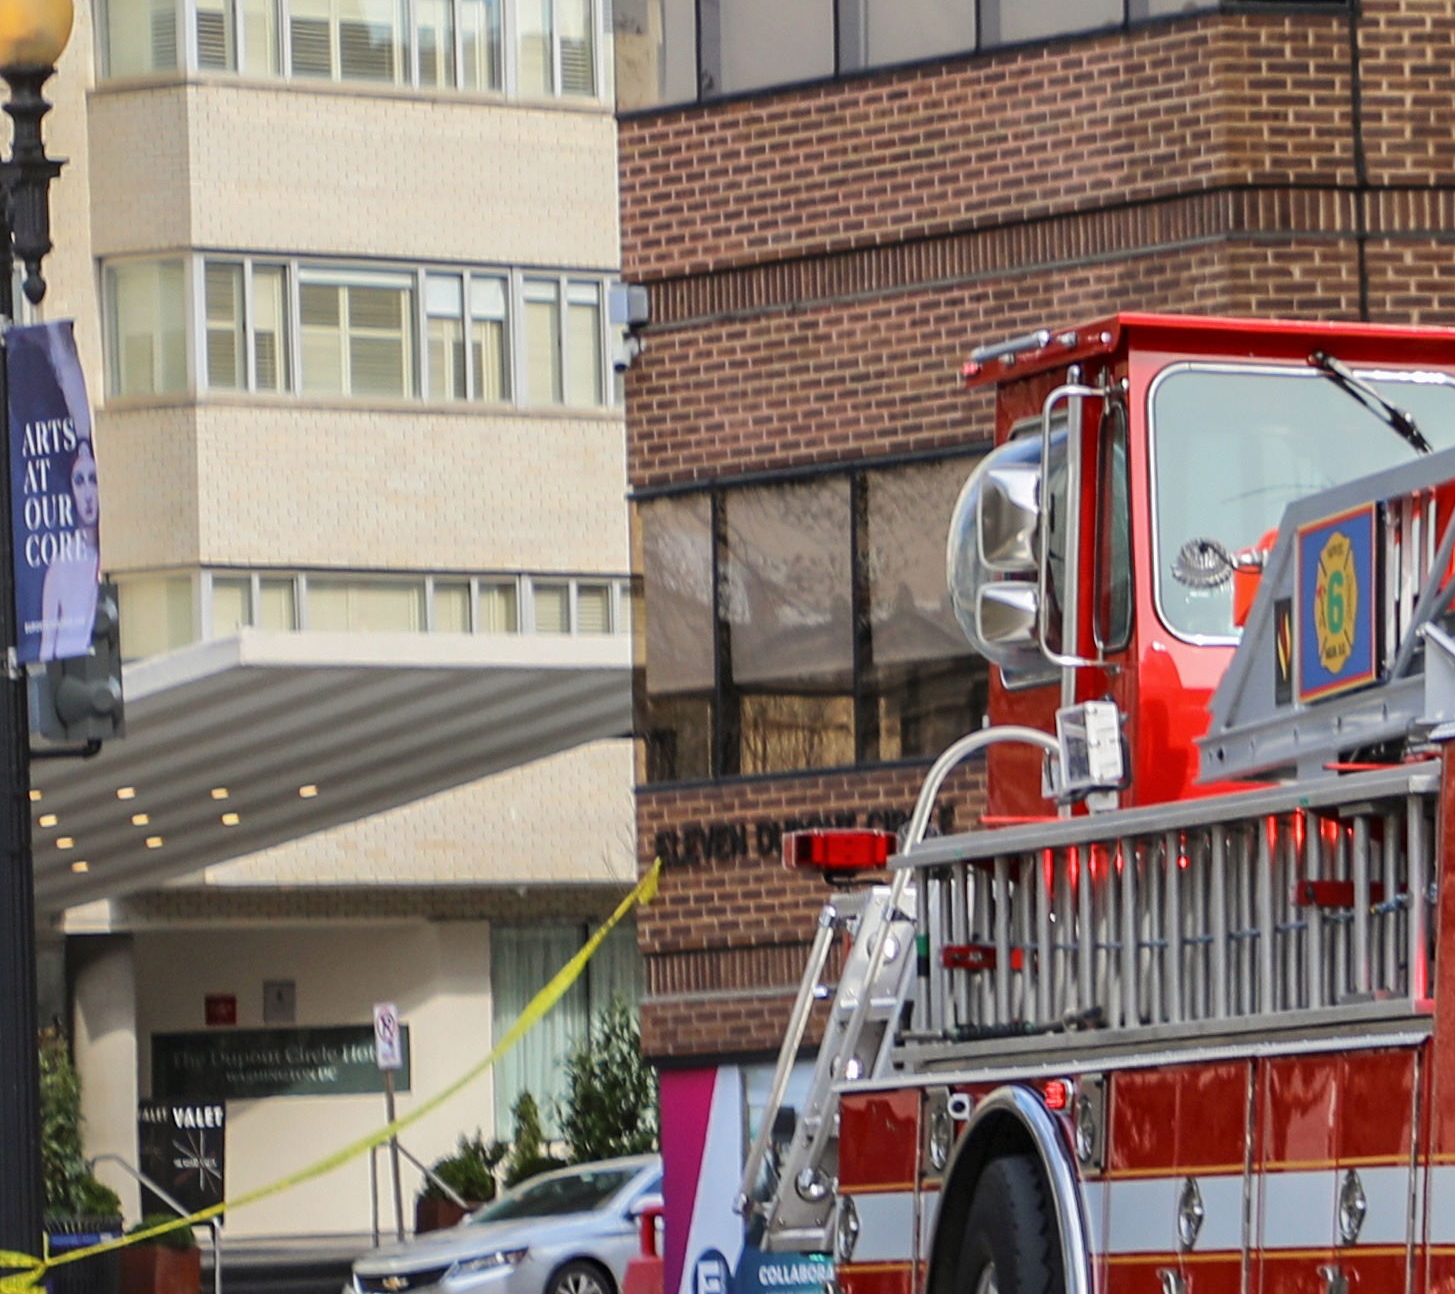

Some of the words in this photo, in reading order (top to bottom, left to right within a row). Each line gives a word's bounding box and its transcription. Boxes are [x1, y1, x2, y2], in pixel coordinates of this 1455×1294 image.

[22, 417, 77, 457] ARTS
[23, 458, 51, 495] AT
[24, 493, 74, 531] OUR
[25, 528, 89, 569] CORE
[1327, 570, 1345, 636] 6
[172, 1106, 224, 1129] VALET
